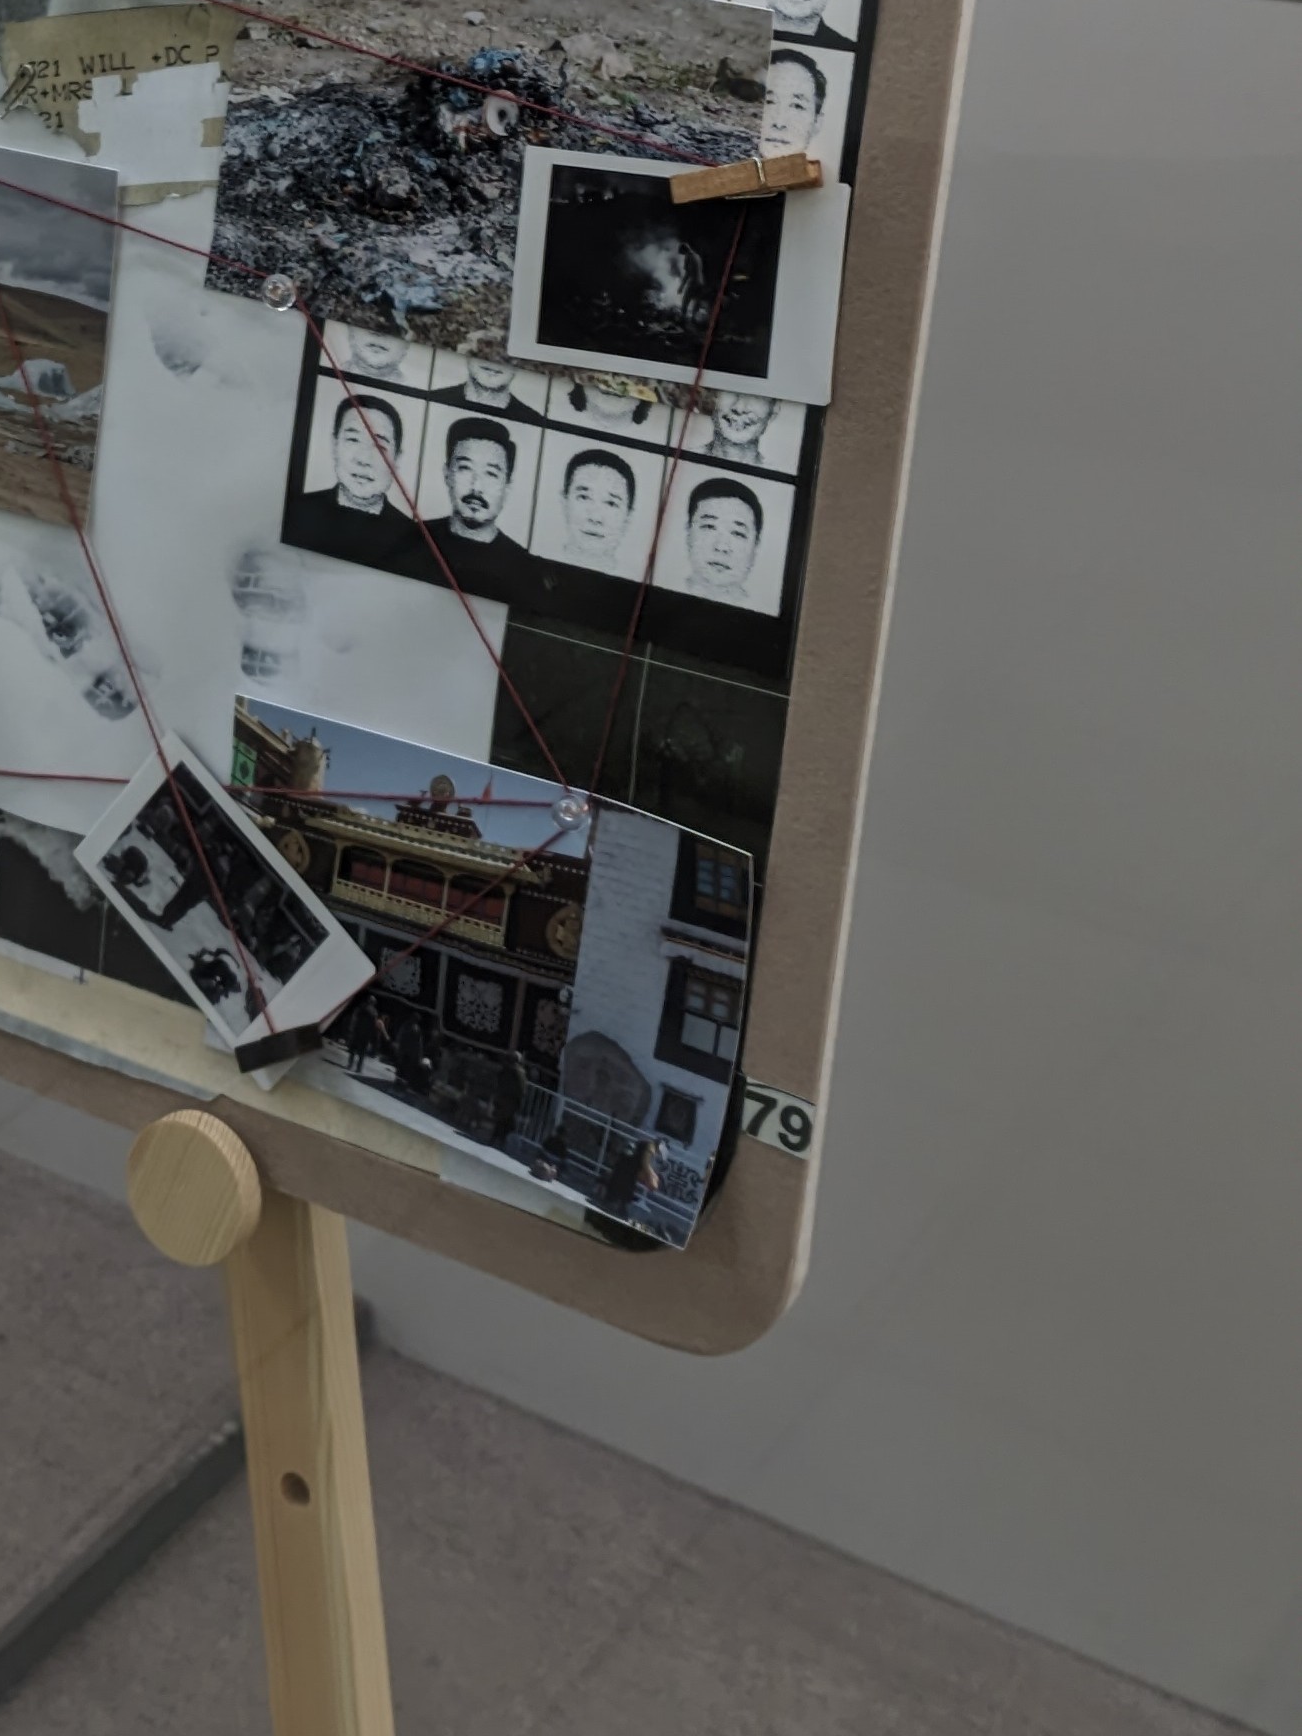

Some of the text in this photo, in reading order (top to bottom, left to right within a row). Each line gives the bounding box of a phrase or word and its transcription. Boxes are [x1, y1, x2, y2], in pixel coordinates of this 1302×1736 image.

[79, 51, 135, 75] WILL
[206, 45, 219, 62] P
[744, 1090, 812, 1152] 79
